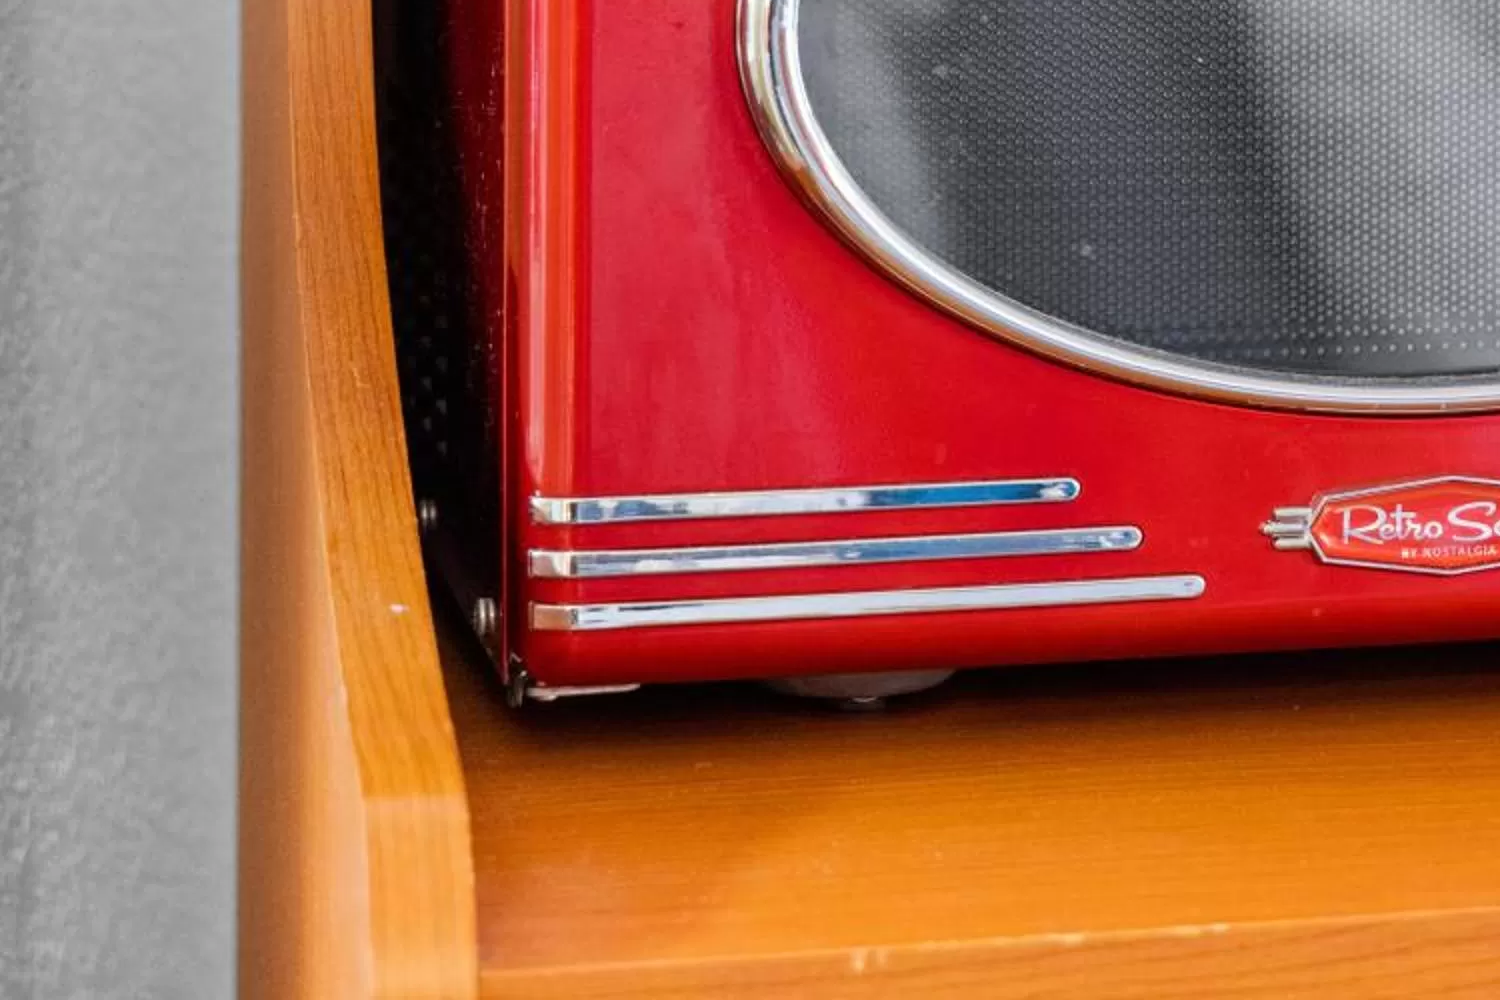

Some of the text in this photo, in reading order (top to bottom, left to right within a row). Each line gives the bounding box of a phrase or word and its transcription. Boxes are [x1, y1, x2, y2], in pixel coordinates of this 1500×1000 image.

[1339, 504, 1443, 545] Retro
[1400, 545, 1498, 560] BY NOSTALGIA
